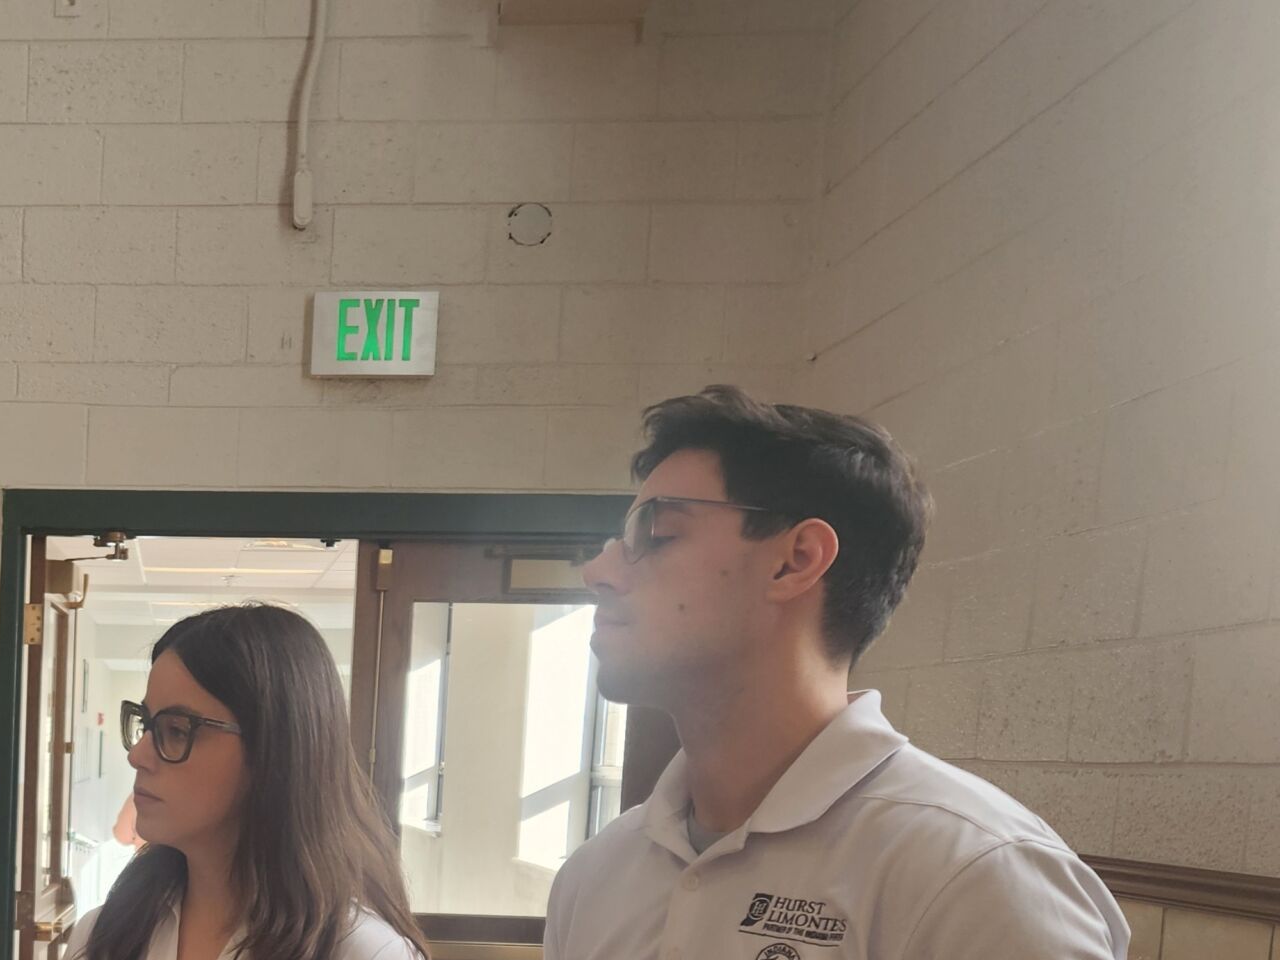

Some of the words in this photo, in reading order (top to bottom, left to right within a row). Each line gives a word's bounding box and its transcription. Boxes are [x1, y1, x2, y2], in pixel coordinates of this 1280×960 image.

[336, 299, 420, 361] EXIT
[773, 896, 826, 915] HURST
[766, 910, 847, 933] LIMONTES
